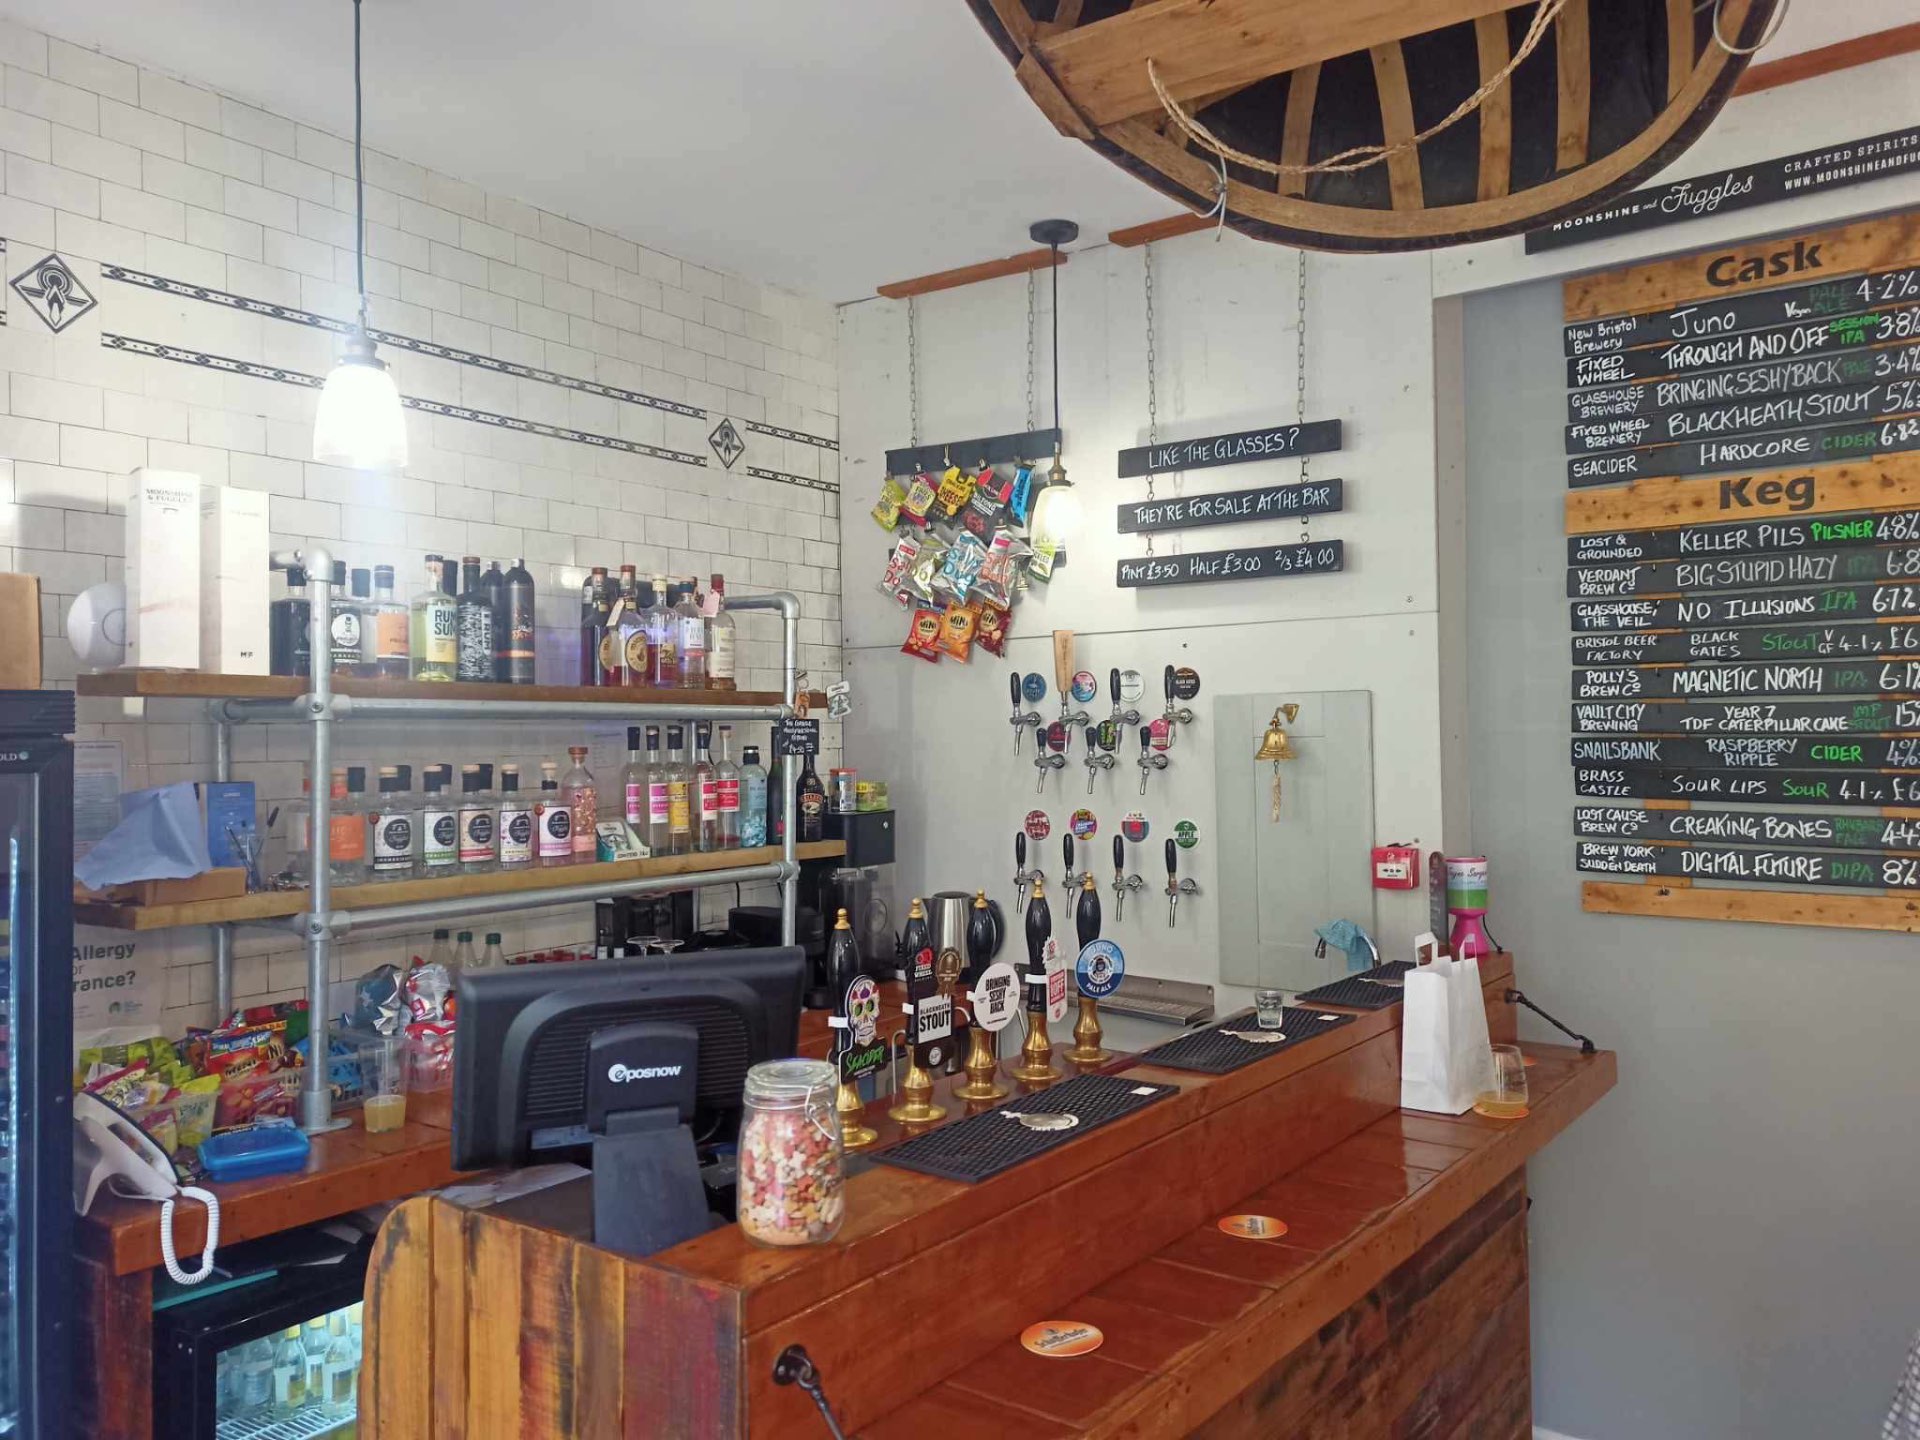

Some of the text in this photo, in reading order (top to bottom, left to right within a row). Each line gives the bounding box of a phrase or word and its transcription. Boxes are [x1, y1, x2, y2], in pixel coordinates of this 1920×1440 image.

[1784, 135, 1918, 173] CRAFTED SPIRITS
[1552, 173, 1754, 231] MOONSHINE and Fuggles
[1706, 241, 1823, 289] Cask
[1568, 317, 1637, 341] New Bristol
[1669, 302, 1812, 338] Juno Vegan
[1829, 312, 1881, 333] SESSION
[1574, 338, 1623, 355] Brewery
[1660, 336, 1743, 370] THROUGH
[1749, 333, 1786, 361] AND
[1790, 325, 1829, 354] OFF
[1840, 329, 1866, 345] IPA
[1575, 355, 1624, 374] FIXED
[1577, 368, 1636, 387] WHEEL
[1657, 374, 1736, 407] BRINGING
[1791, 357, 1843, 387] BACK
[1571, 386, 1645, 407] GLASSHOUSE
[1580, 400, 1639, 418] BREWERY
[1667, 397, 1802, 438] BLACKHEATH
[1804, 385, 1880, 416] STOUT
[1571, 418, 1650, 439] FIXED WHEEL
[1149, 445, 1180, 469] LIKE
[1183, 443, 1211, 464] THE
[1214, 433, 1285, 460] GLASSES
[1700, 437, 1811, 466] HARDCORE
[1822, 431, 1877, 451] CIDER
[1573, 455, 1638, 478] SEACIDER
[1719, 476, 1816, 511] Keg
[1133, 486, 1331, 524] THEY'RE FOR SALE AT THE BAR
[1580, 534, 1627, 549] LOST &
[1680, 528, 1752, 553] KELLER
[1758, 524, 1805, 547] PILS
[1810, 520, 1874, 542] PILSNER
[1577, 547, 1643, 560] GROUNDED
[1121, 563, 1147, 581] PINT
[1190, 556, 1220, 576] HALF
[1578, 566, 1642, 583] VERDANT
[1675, 562, 1714, 587] BIG
[1716, 557, 1784, 585] STUPID
[1789, 554, 1838, 581] HAZY
[1579, 582, 1615, 595] BREW
[1677, 602, 1711, 622] NO
[1723, 596, 1815, 619] ILLUSIONS
[1819, 589, 1857, 612] IPA
[1582, 615, 1652, 628] THE VEIL
[1575, 634, 1658, 649] BRISTOL BEER
[1690, 631, 1740, 646] BLACK
[1586, 649, 1643, 661] FACTORY
[1690, 645, 1742, 658] GATES
[1585, 669, 1640, 685] POLLY'S
[1672, 668, 1759, 694] MAGNETIC
[1764, 665, 1823, 693] NORTH
[1833, 670, 1868, 688] IPA
[1580, 684, 1620, 697] BREW
[1576, 703, 1646, 721] VAULT CITY
[1724, 705, 1762, 720] YEAR
[1765, 705, 1777, 718] 7
[1580, 719, 1639, 732] BREWING
[1680, 716, 1715, 731] TDF
[1718, 716, 1813, 732] CATERPILLAR
[1813, 716, 1849, 732] CAKE
[1574, 739, 1662, 761] SNAILSBANK
[1706, 738, 1798, 754] RASPBERRY
[1811, 745, 1863, 763] CIDER
[1724, 752, 1779, 767] RIPPLE
[1579, 769, 1625, 782] BRASS
[1580, 784, 1631, 796] CASTLE
[1729, 780, 1767, 795] LIPS
[1576, 809, 1649, 823] LOST CAUSE
[1177, 830, 1194, 839] APPLE
[1580, 821, 1617, 834] BREW
[1669, 813, 1833, 840] CREAKING BONES
[1582, 843, 1655, 858] BREW YORK
[1580, 858, 1656, 873] SUDDEN DEATH
[1680, 851, 1750, 877] DIGITAL
[1752, 853, 1823, 882] FUTURE
[1831, 861, 1875, 883] DIPA
[1091, 943, 1113, 953] JUNO
[1085, 982, 1112, 993] PALE ALE
[919, 1010, 951, 1032] STOUT
